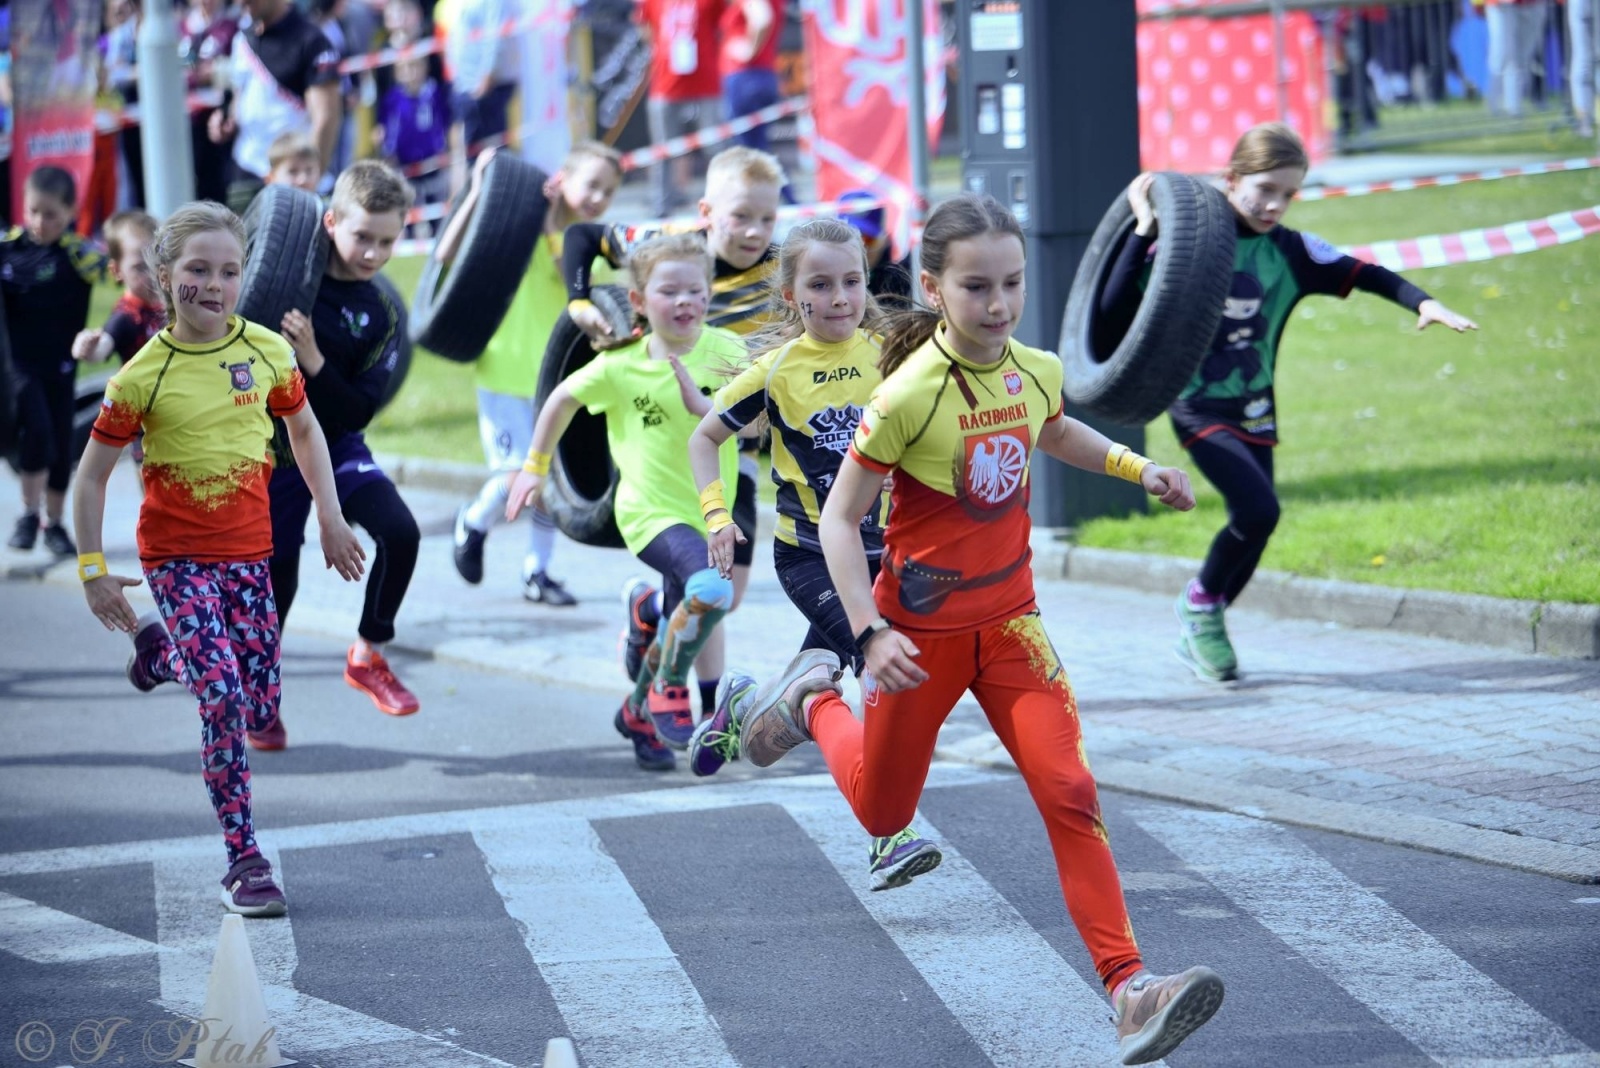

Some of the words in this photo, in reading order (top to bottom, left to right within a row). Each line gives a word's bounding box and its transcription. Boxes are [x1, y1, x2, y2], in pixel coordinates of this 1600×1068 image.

[177, 283, 199, 304] 102
[801, 301, 814, 318] 97
[234, 392, 260, 407] NIKA
[958, 401, 1028, 431] RACIBORKI
[813, 431, 856, 448] SOCI
